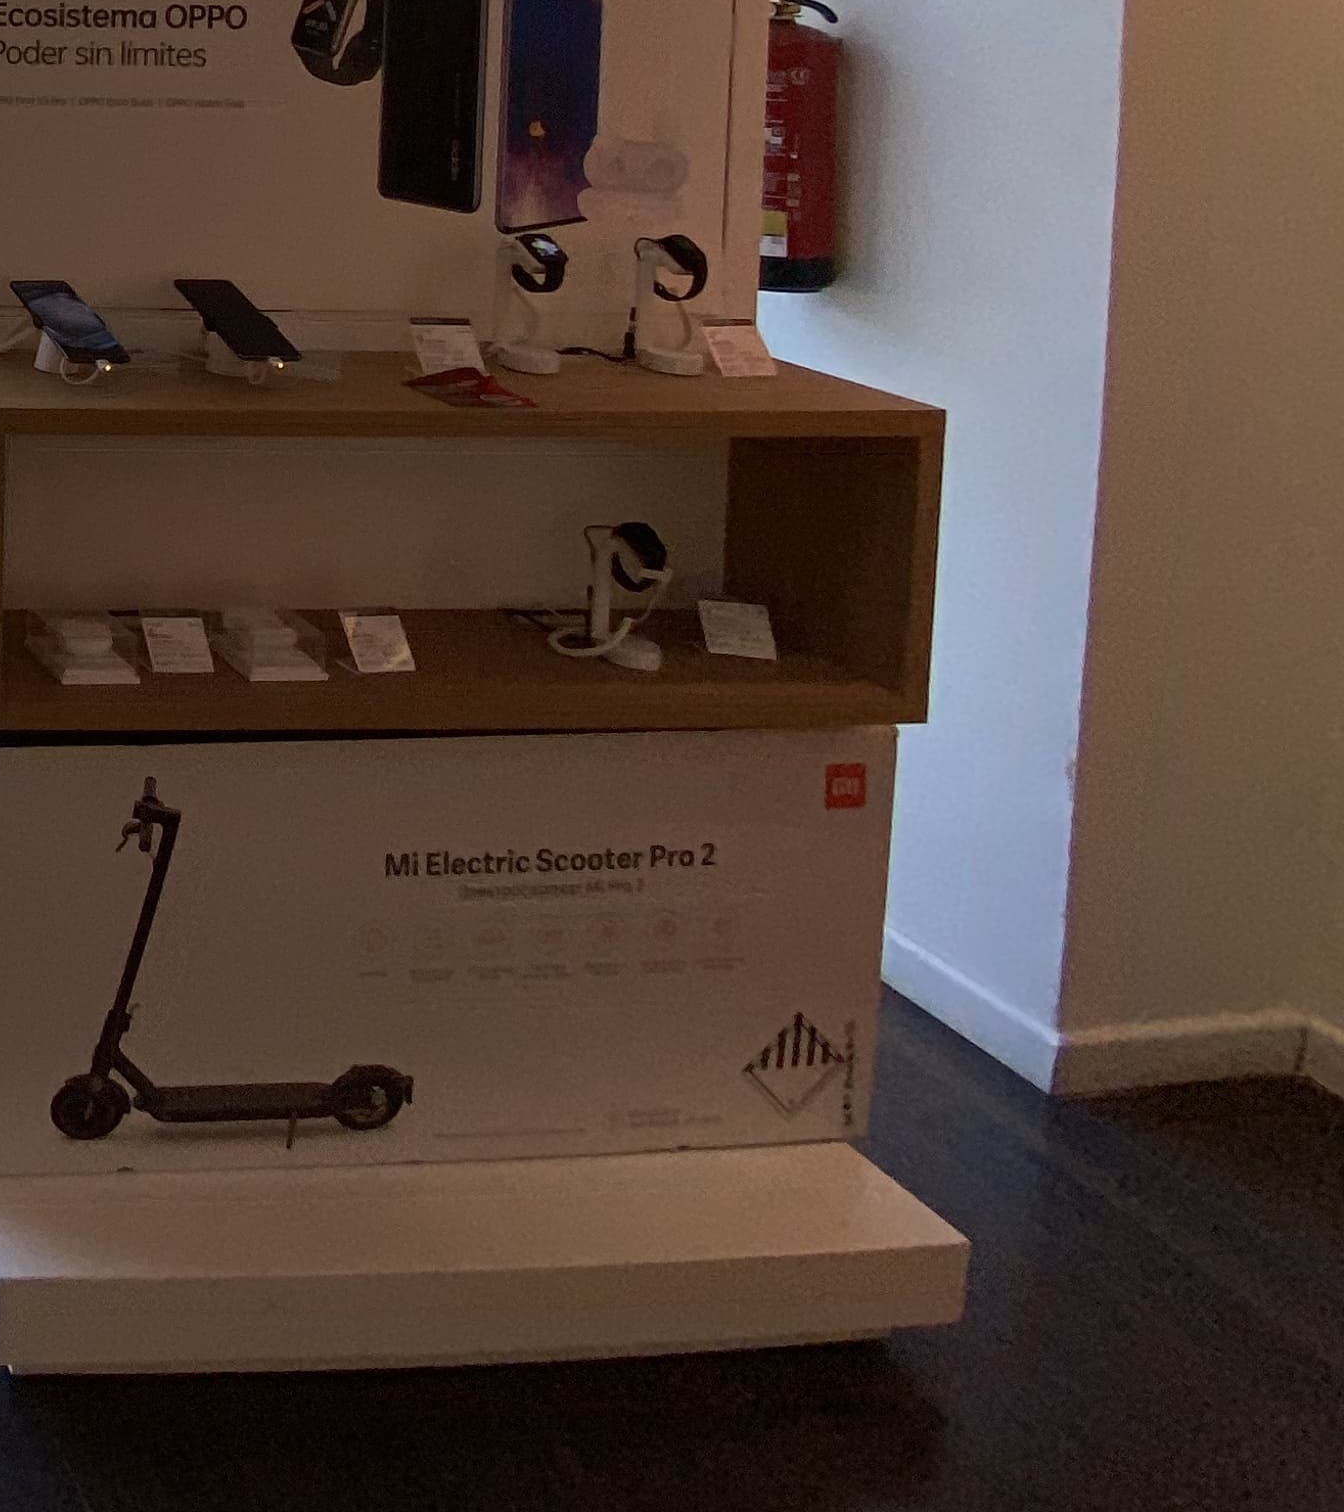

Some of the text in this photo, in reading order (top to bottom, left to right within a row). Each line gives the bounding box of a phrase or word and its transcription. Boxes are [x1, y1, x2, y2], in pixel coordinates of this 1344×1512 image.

[165, 4, 249, 30] OPPO
[74, 41, 113, 66] sin
[385, 842, 718, 878] Mi Electric Scooter Pro 2
